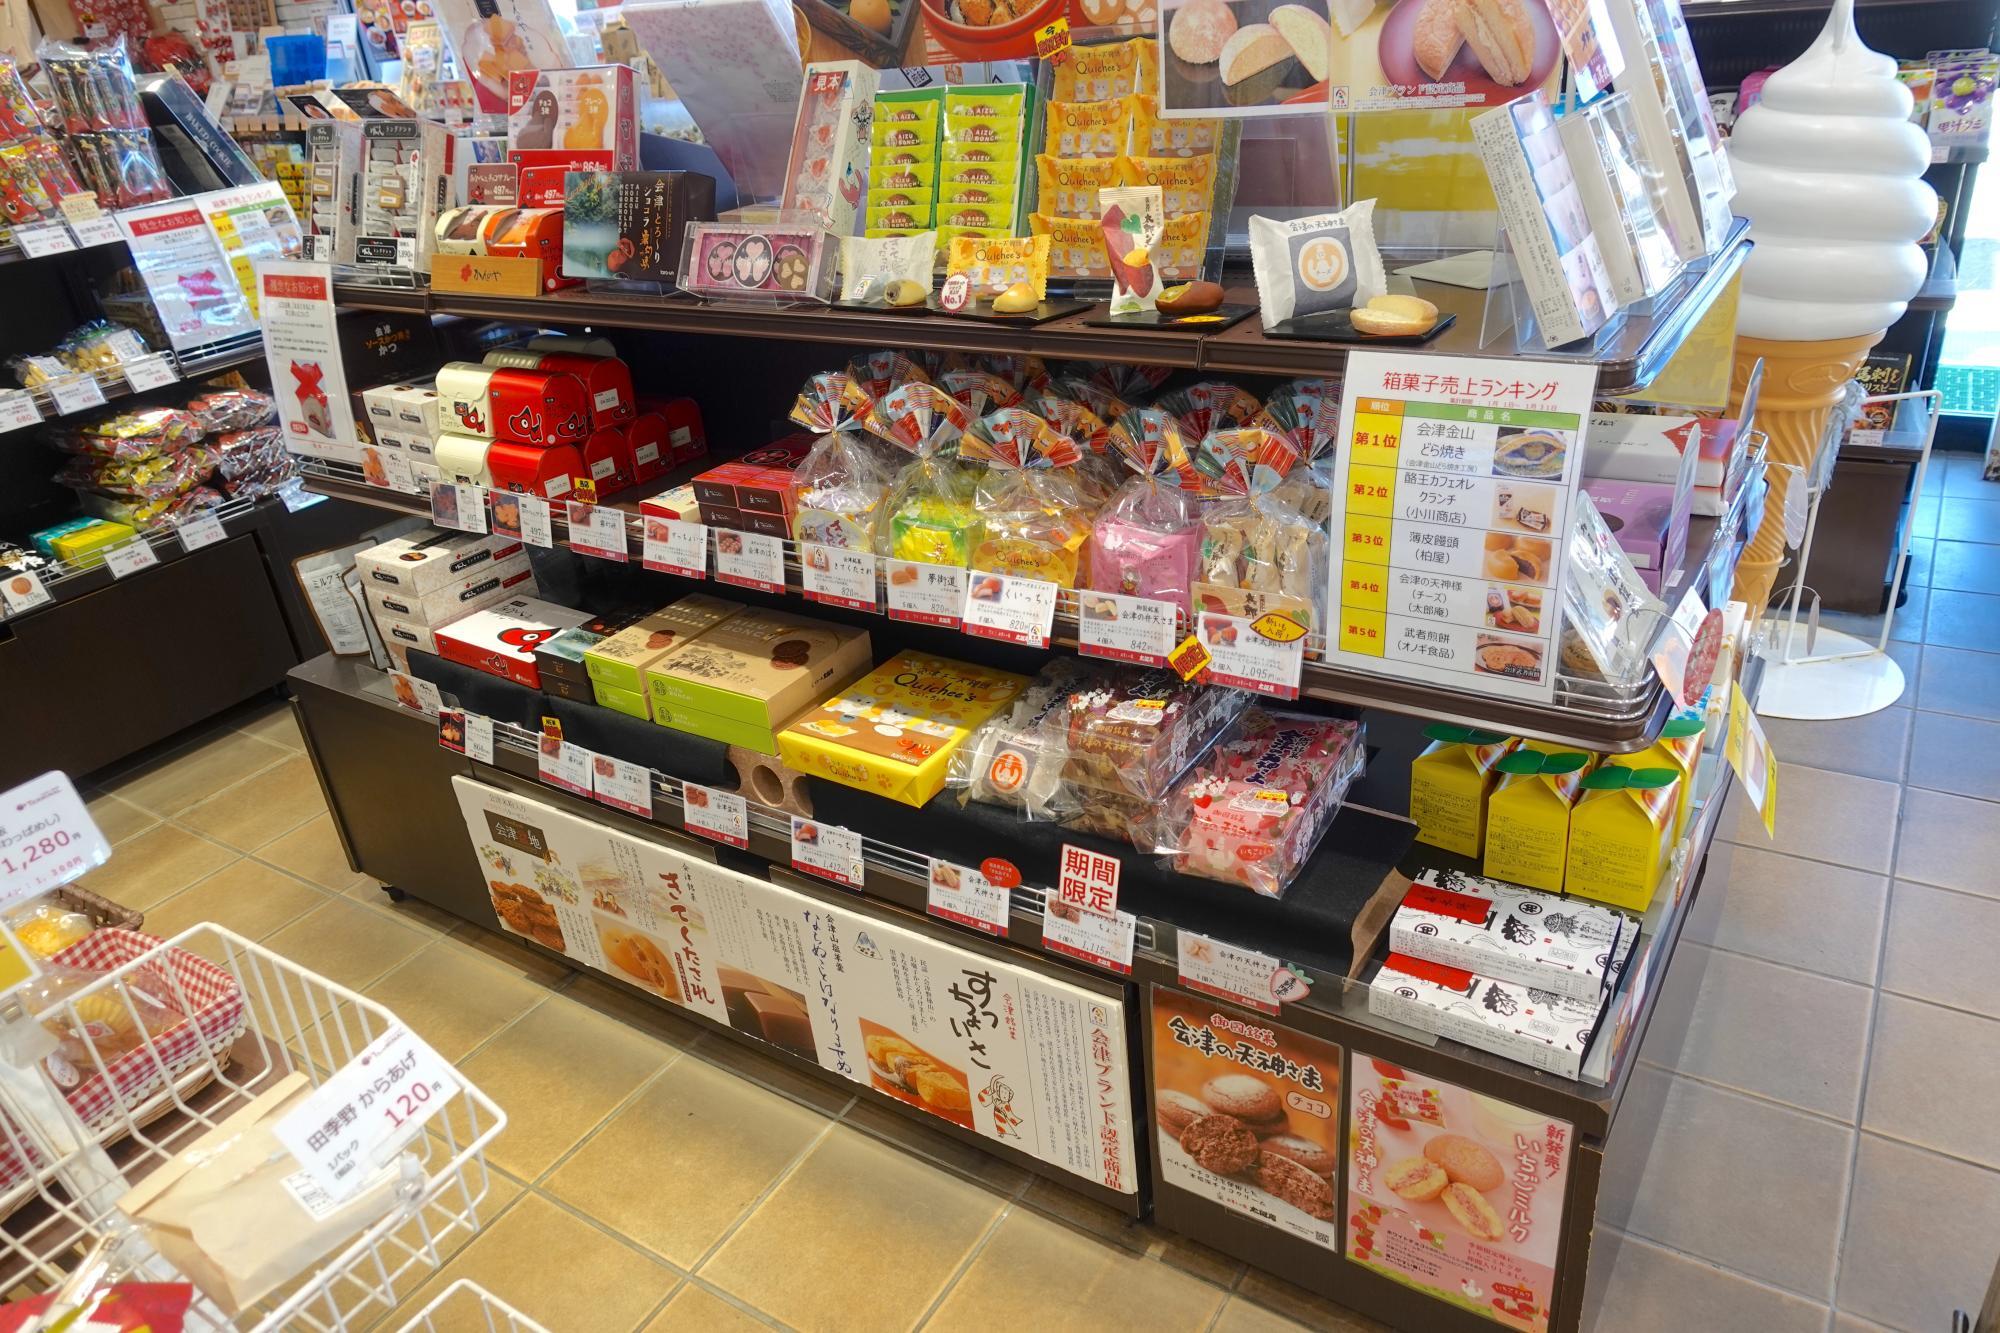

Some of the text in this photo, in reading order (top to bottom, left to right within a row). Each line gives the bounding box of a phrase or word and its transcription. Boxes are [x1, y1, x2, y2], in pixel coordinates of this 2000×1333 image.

[814, 73, 840, 91] 見本
[138, 213, 201, 233] 残念なお知らせ
[975, 249, 1021, 262] Quichee's
[269, 279, 321, 294] 残念なお知らせ
[1383, 370, 1560, 401] 箱菓子売上ランキング
[1370, 401, 1390, 412] 順位
[1417, 422, 1475, 441] 会津金山
[1420, 444, 1465, 459] どら焼き
[1404, 473, 1475, 491] 酪王カフェオレ
[1419, 491, 1457, 505] クランチ
[1409, 531, 1460, 548] 薄皮饅頭
[927, 573, 959, 588] 夢街道
[1400, 573, 1463, 592] 会津の天神様
[1121, 611, 1174, 627] 会津の弁天さま
[1265, 616, 1287, 631] 新いも
[1404, 626, 1451, 644] 武者煎餅
[893, 671, 977, 702] Quichee's
[1065, 849, 1116, 887] 期間
[974, 888, 1002, 901] 天神さま
[1062, 877, 1113, 914] 限定
[1219, 950, 1277, 972] 会津の天神さま
[1226, 963, 1269, 980] いちごミルク
[1168, 1015, 1324, 1093] 会津の天神さま
[306, 1049, 417, 1153] 田季野 からあげ
[384, 1080, 443, 1129] 120円
[1090, 1028, 1122, 1190] 会津ブランド認定商品
[1292, 1095, 1326, 1115] チョコ
[327, 1139, 360, 1171] 1パック
[1509, 1134, 1541, 1244] いちごミルク
